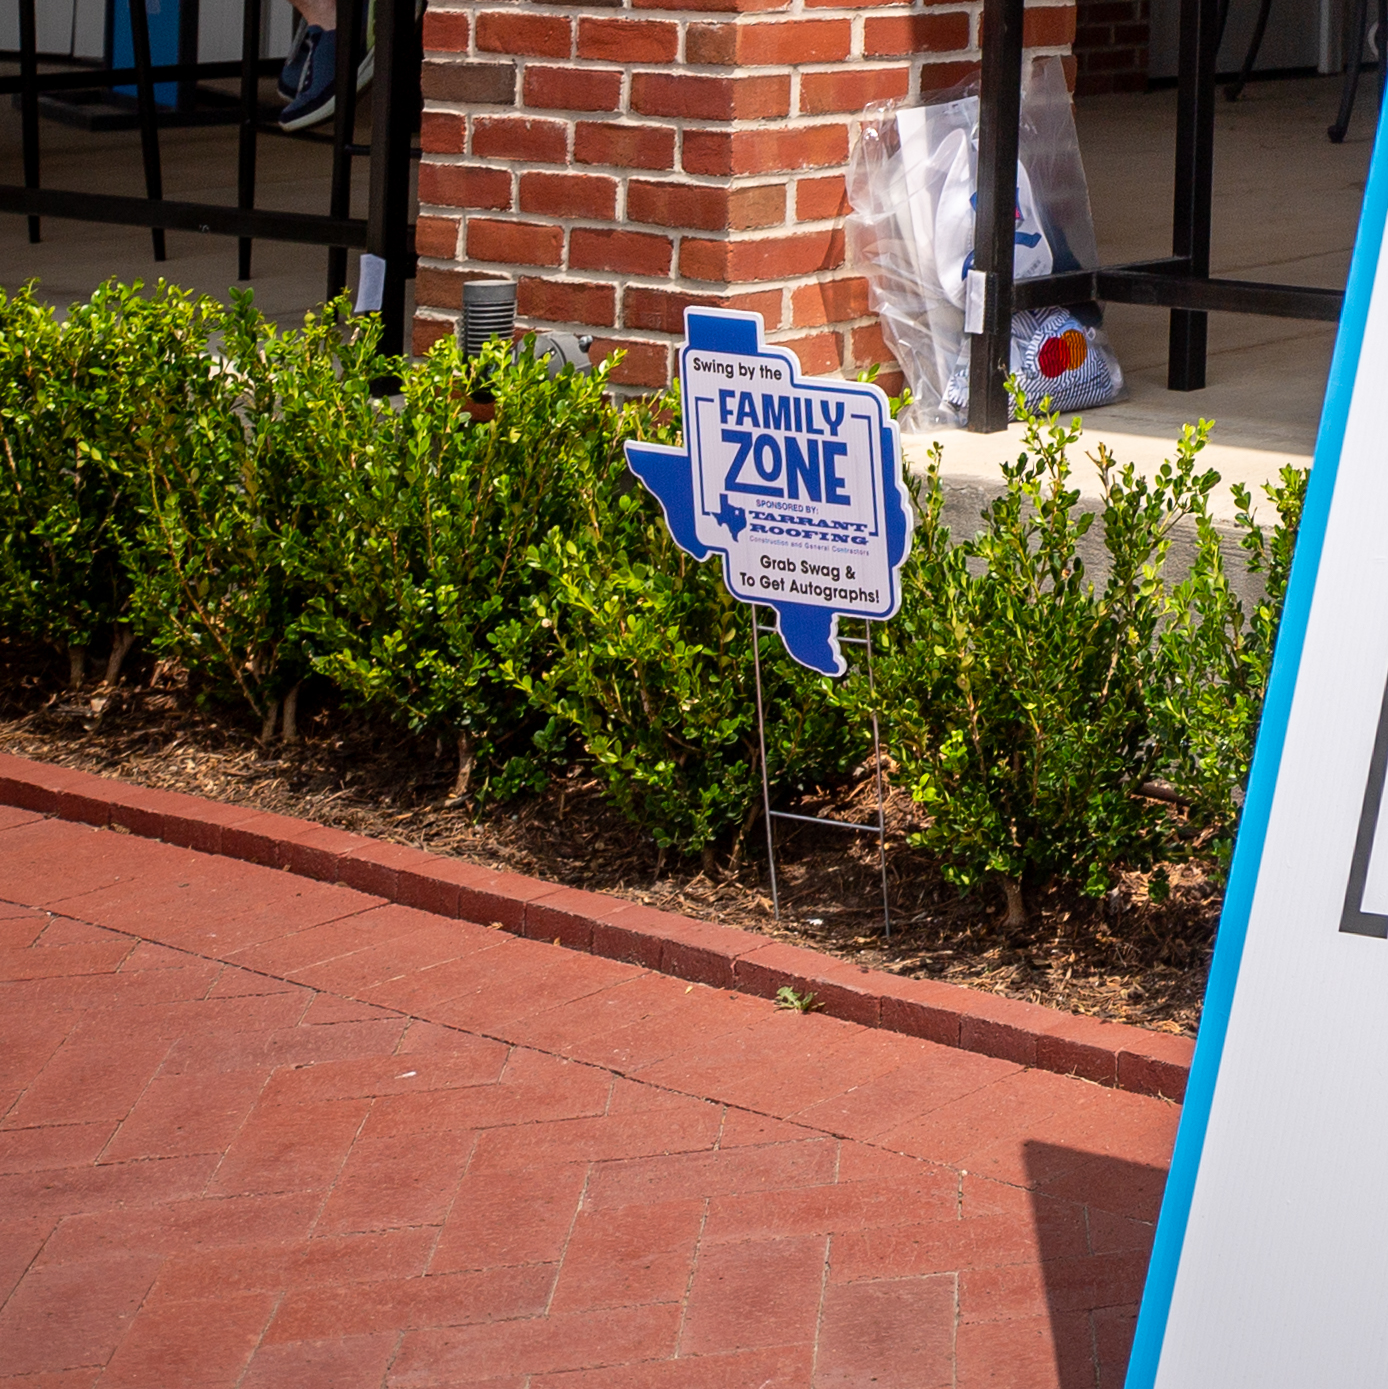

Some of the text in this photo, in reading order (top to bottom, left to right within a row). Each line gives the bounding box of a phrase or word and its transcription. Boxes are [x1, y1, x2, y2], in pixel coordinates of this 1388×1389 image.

[692, 356, 783, 381] Swing by the
[718, 389, 845, 437] FAMILY
[721, 428, 851, 506] ZONE
[756, 499, 819, 515] SPONSORED BY:
[748, 510, 868, 533] TARRANT
[749, 523, 869, 546] ROOFING
[749, 535, 870, 557] Construction and General Contractors
[760, 554, 856, 582] Grab Swag &
[739, 572, 880, 604] To Get Autographs!
